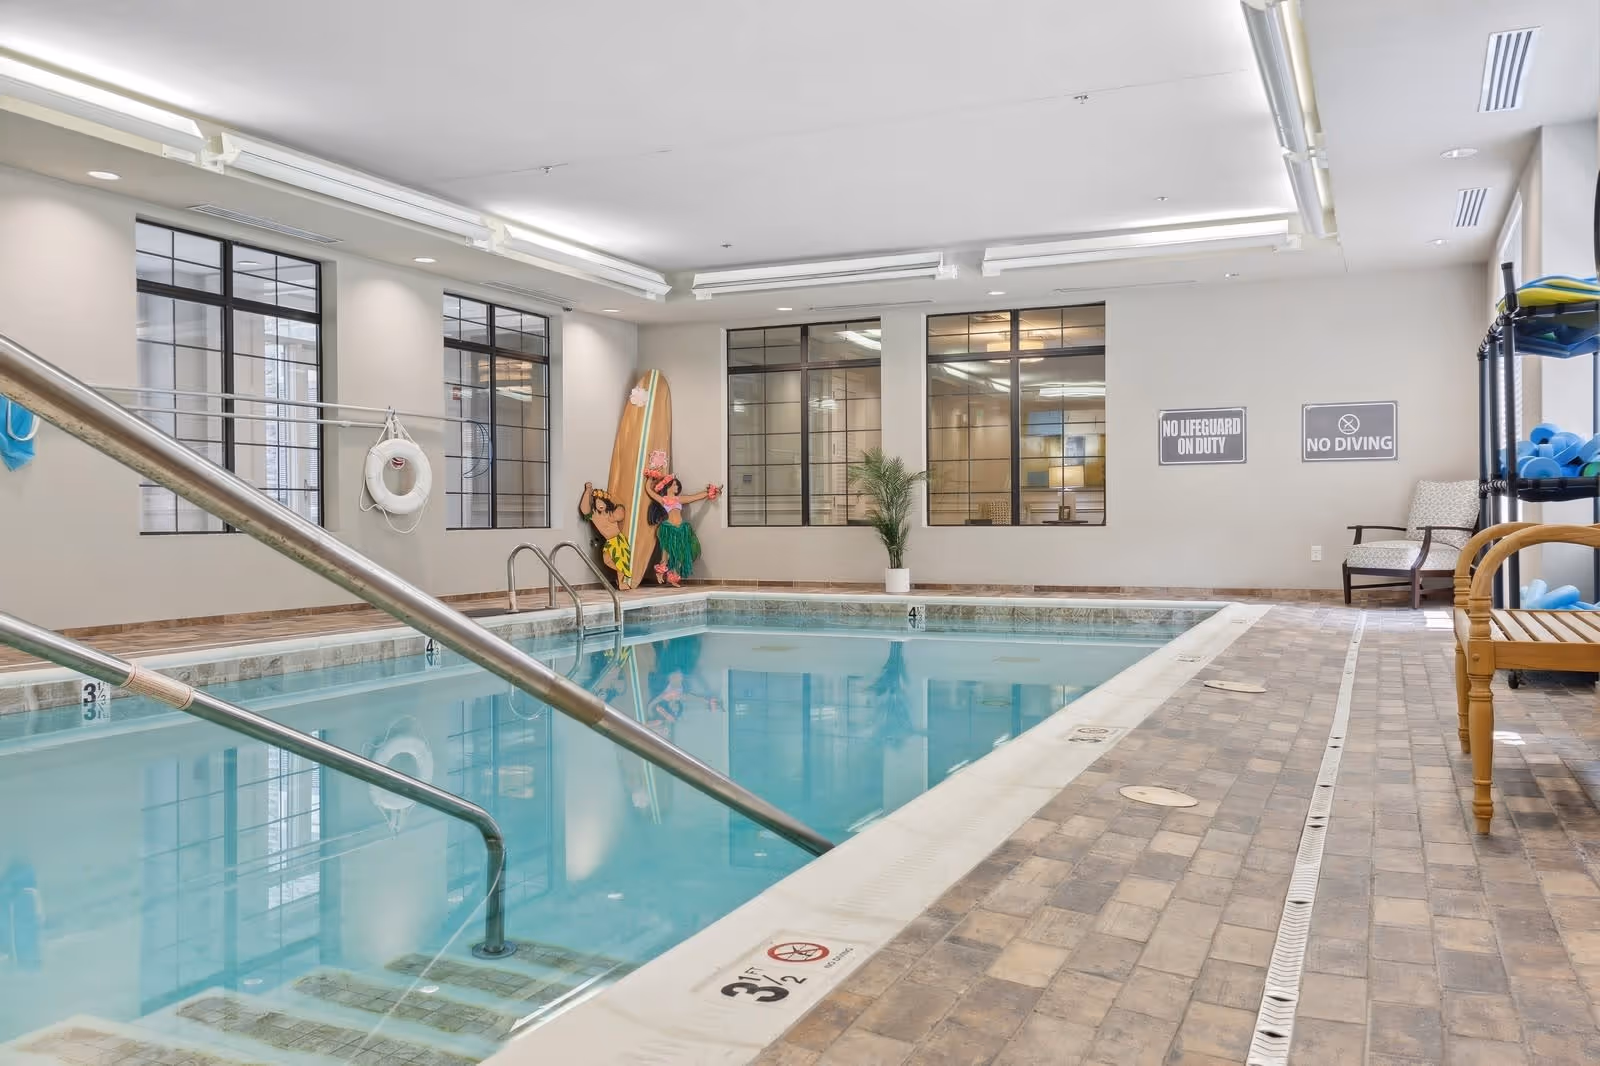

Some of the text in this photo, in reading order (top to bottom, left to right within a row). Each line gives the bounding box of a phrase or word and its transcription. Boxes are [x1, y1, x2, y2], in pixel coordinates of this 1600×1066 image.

[1162, 417, 1241, 437] NO LIFEGUARD
[1177, 436, 1226, 455] ON DUTY
[1306, 435, 1393, 452] NO DIVING
[908, 606, 917, 618] 4
[426, 638, 434, 653] 4
[83, 682, 97, 704] 3
